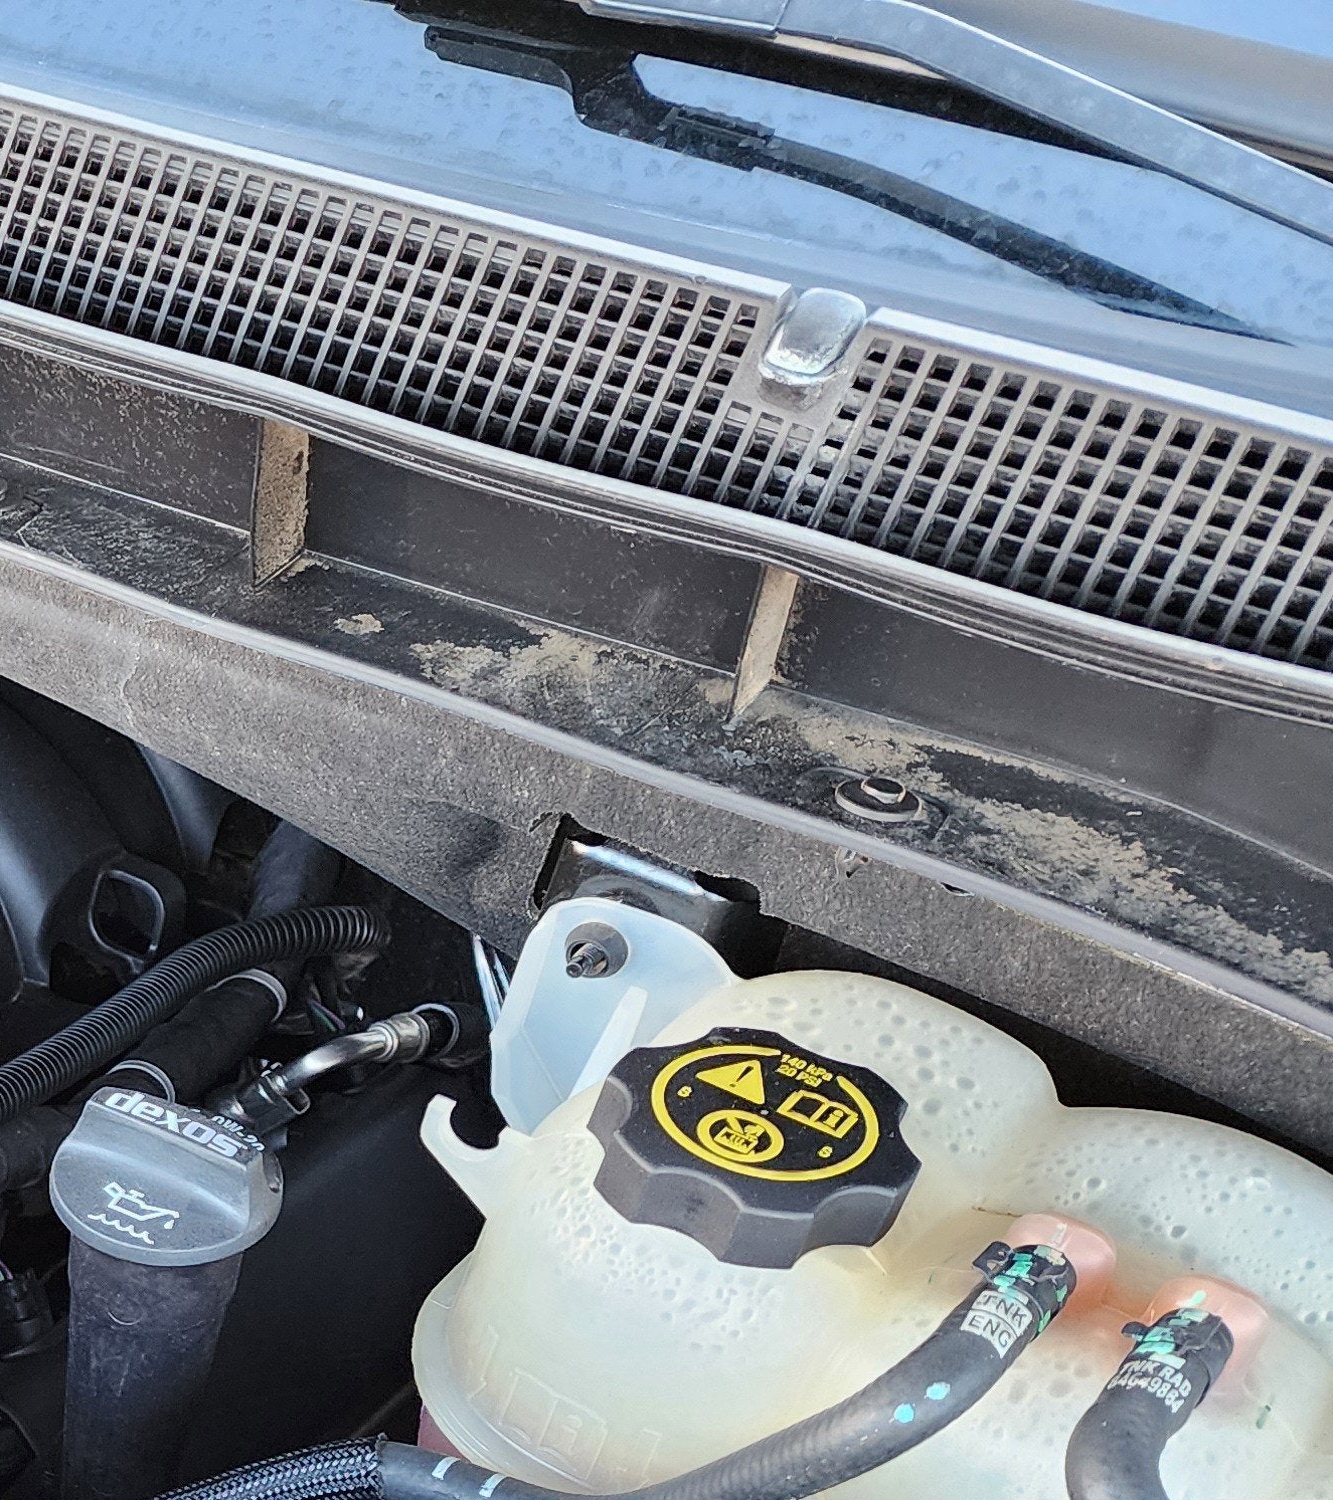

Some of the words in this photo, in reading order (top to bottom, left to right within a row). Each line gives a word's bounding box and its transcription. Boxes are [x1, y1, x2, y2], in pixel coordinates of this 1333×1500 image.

[775, 1064, 798, 1078] 20
[104, 1091, 248, 1158] dexos
[982, 1294, 1027, 1329] TNK
[968, 1313, 1012, 1351] ENG
[1160, 1363, 1192, 1397] RAD
